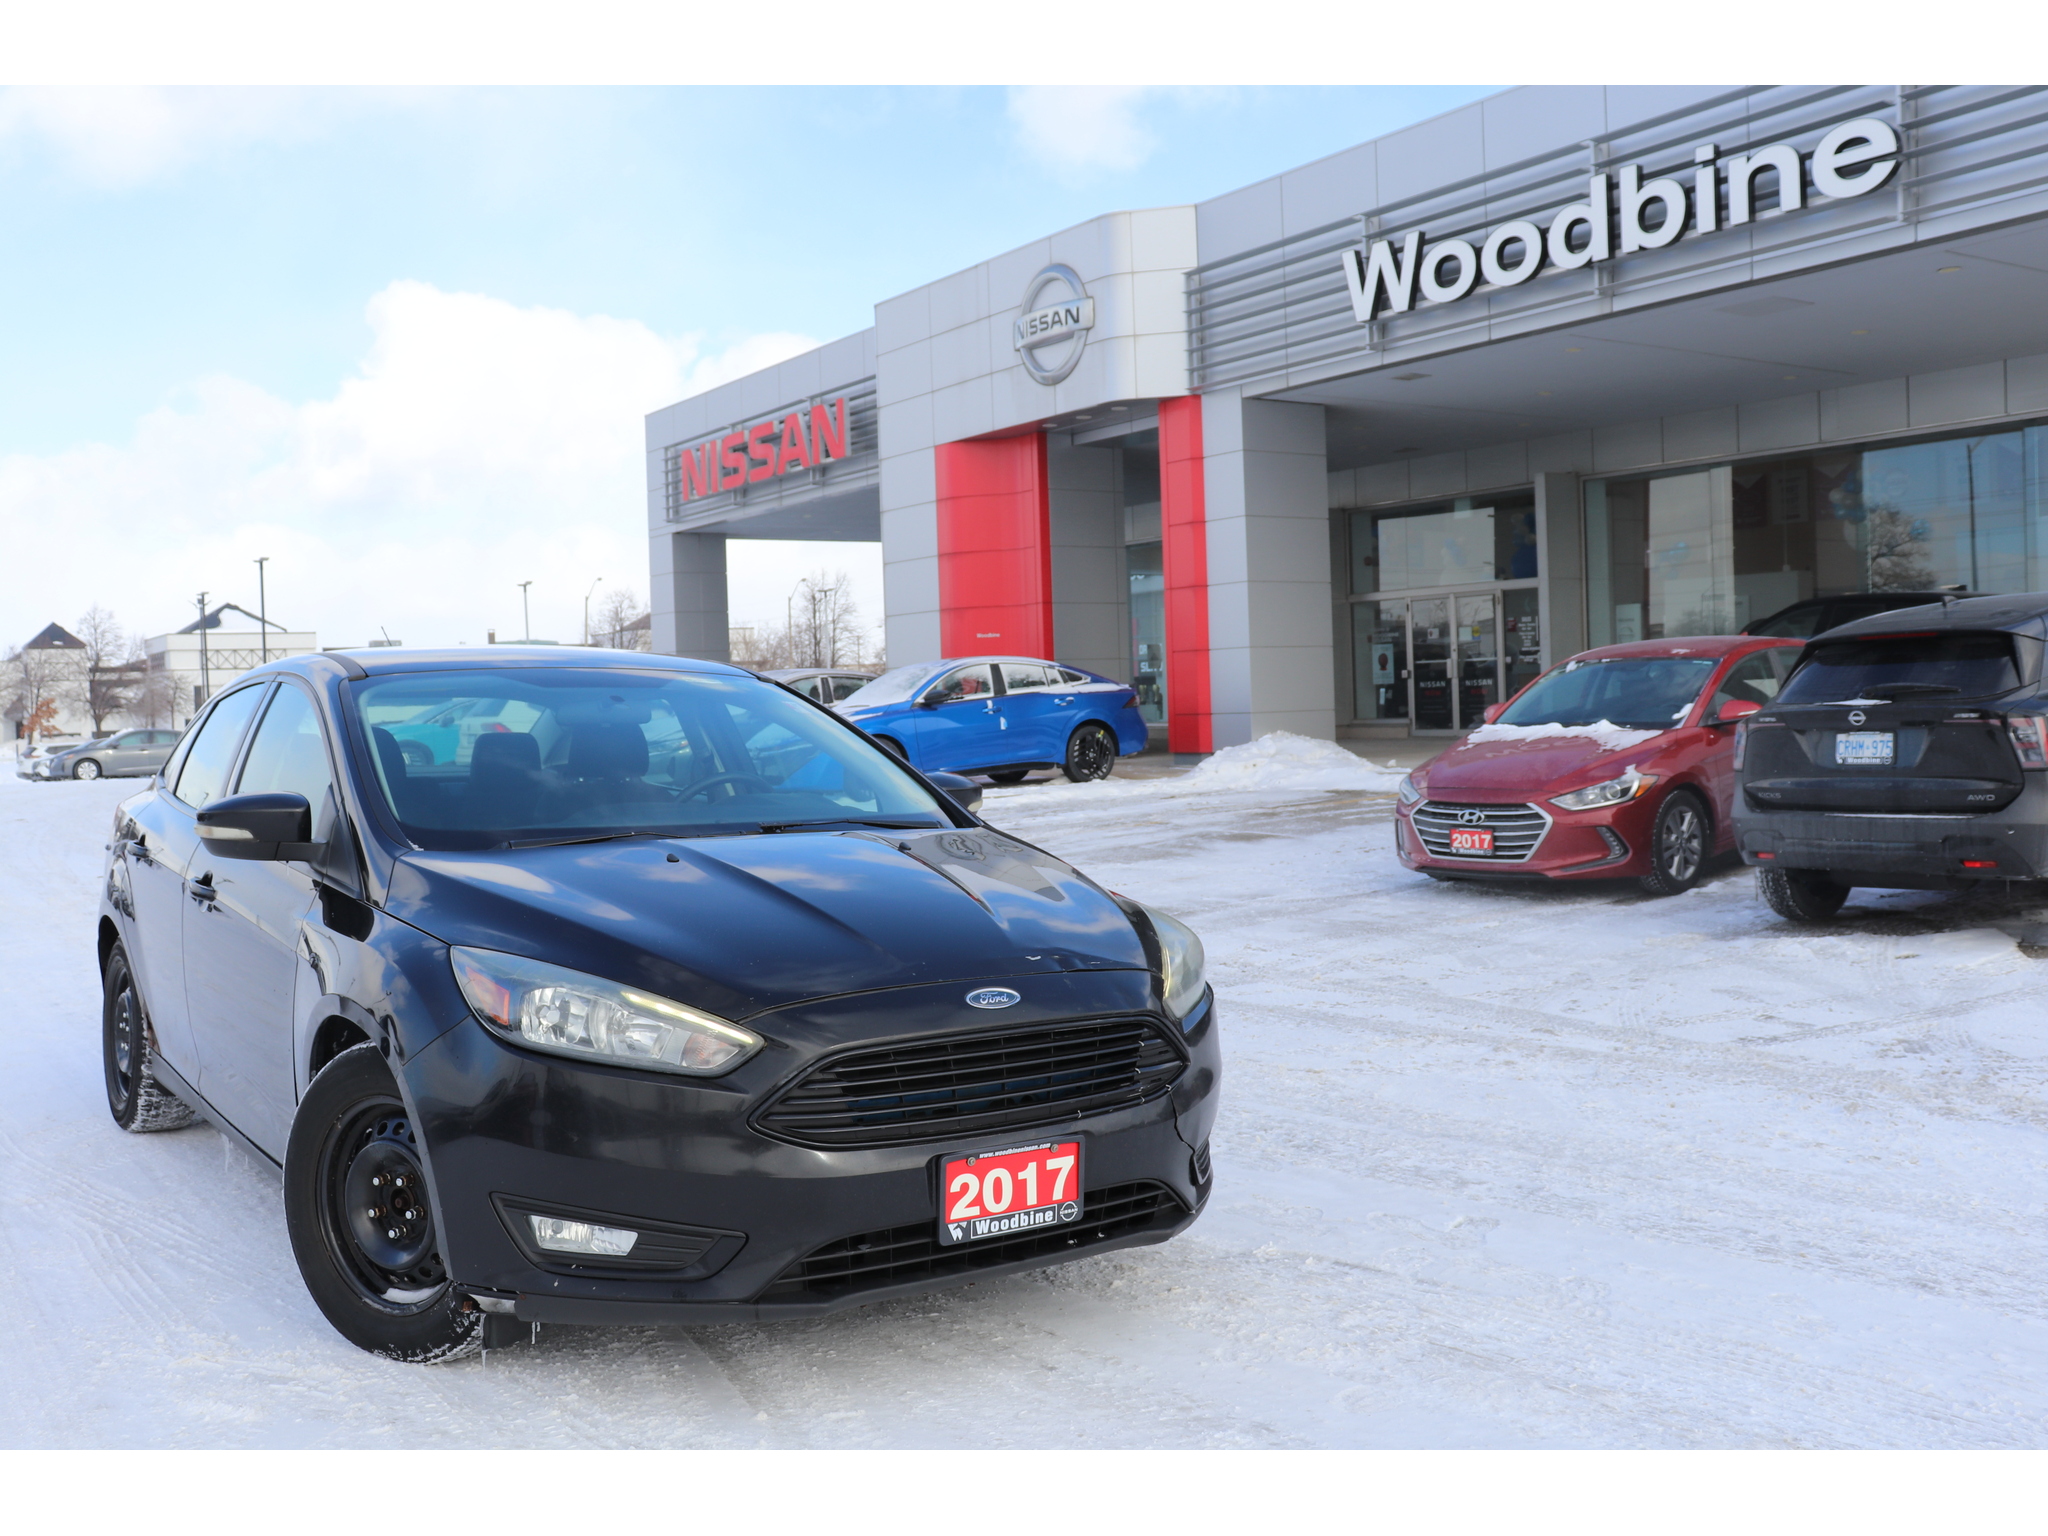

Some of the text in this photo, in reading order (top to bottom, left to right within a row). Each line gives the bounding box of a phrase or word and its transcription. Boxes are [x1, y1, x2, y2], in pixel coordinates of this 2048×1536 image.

[1341, 117, 1900, 322] Woodbine
[1016, 305, 1081, 341] NISSAN
[681, 398, 849, 501] NISSAN
[1465, 679, 1493, 687] NISSAN
[1838, 740, 1893, 756] CRHM 975
[1452, 833, 1492, 849] 2017
[980, 991, 1009, 1005] Ford
[950, 1155, 1075, 1220] 2017
[975, 1210, 1054, 1235] Woodbine
